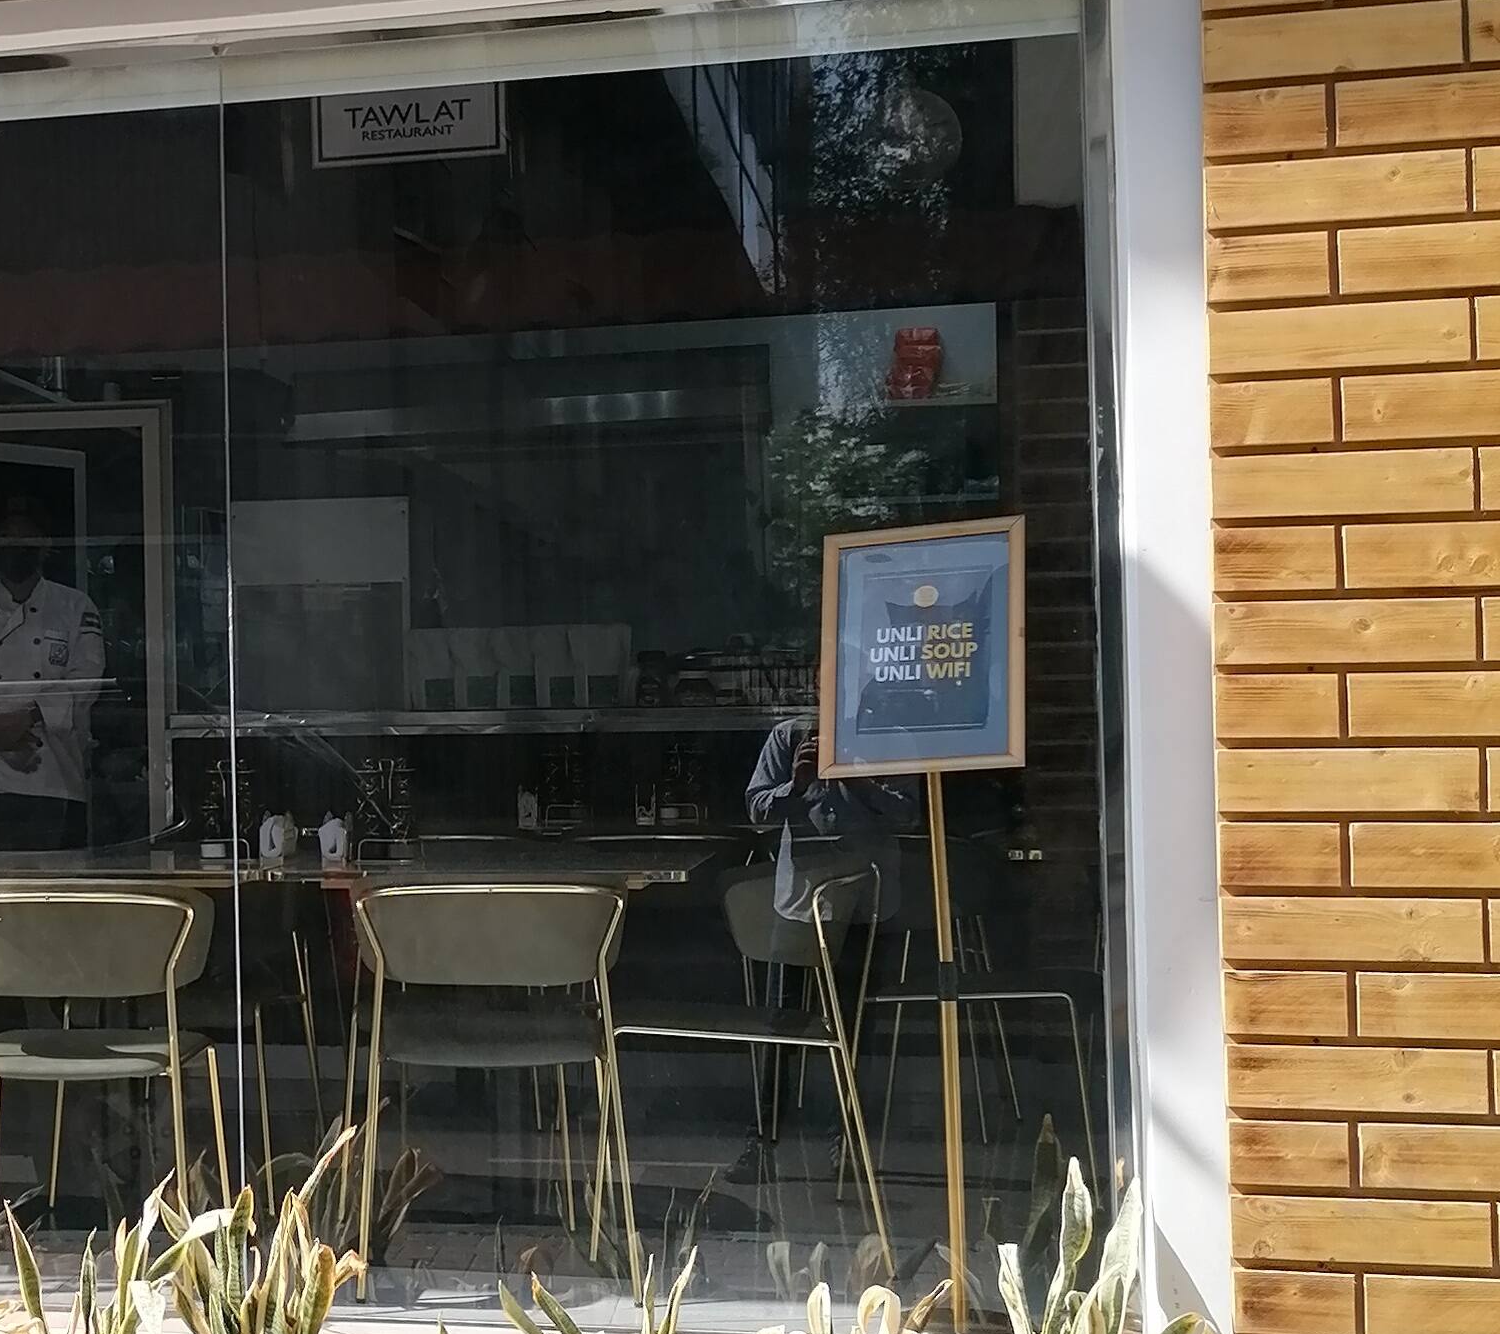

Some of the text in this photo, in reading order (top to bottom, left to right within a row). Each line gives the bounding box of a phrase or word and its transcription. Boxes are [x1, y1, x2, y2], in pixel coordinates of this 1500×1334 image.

[343, 98, 472, 130] TAWLAT
[361, 124, 454, 142] RESTAURANT
[876, 622, 974, 644] UNLI RICE
[869, 641, 979, 663] UNLI SOUP
[874, 661, 971, 682] UNLI WIFI
